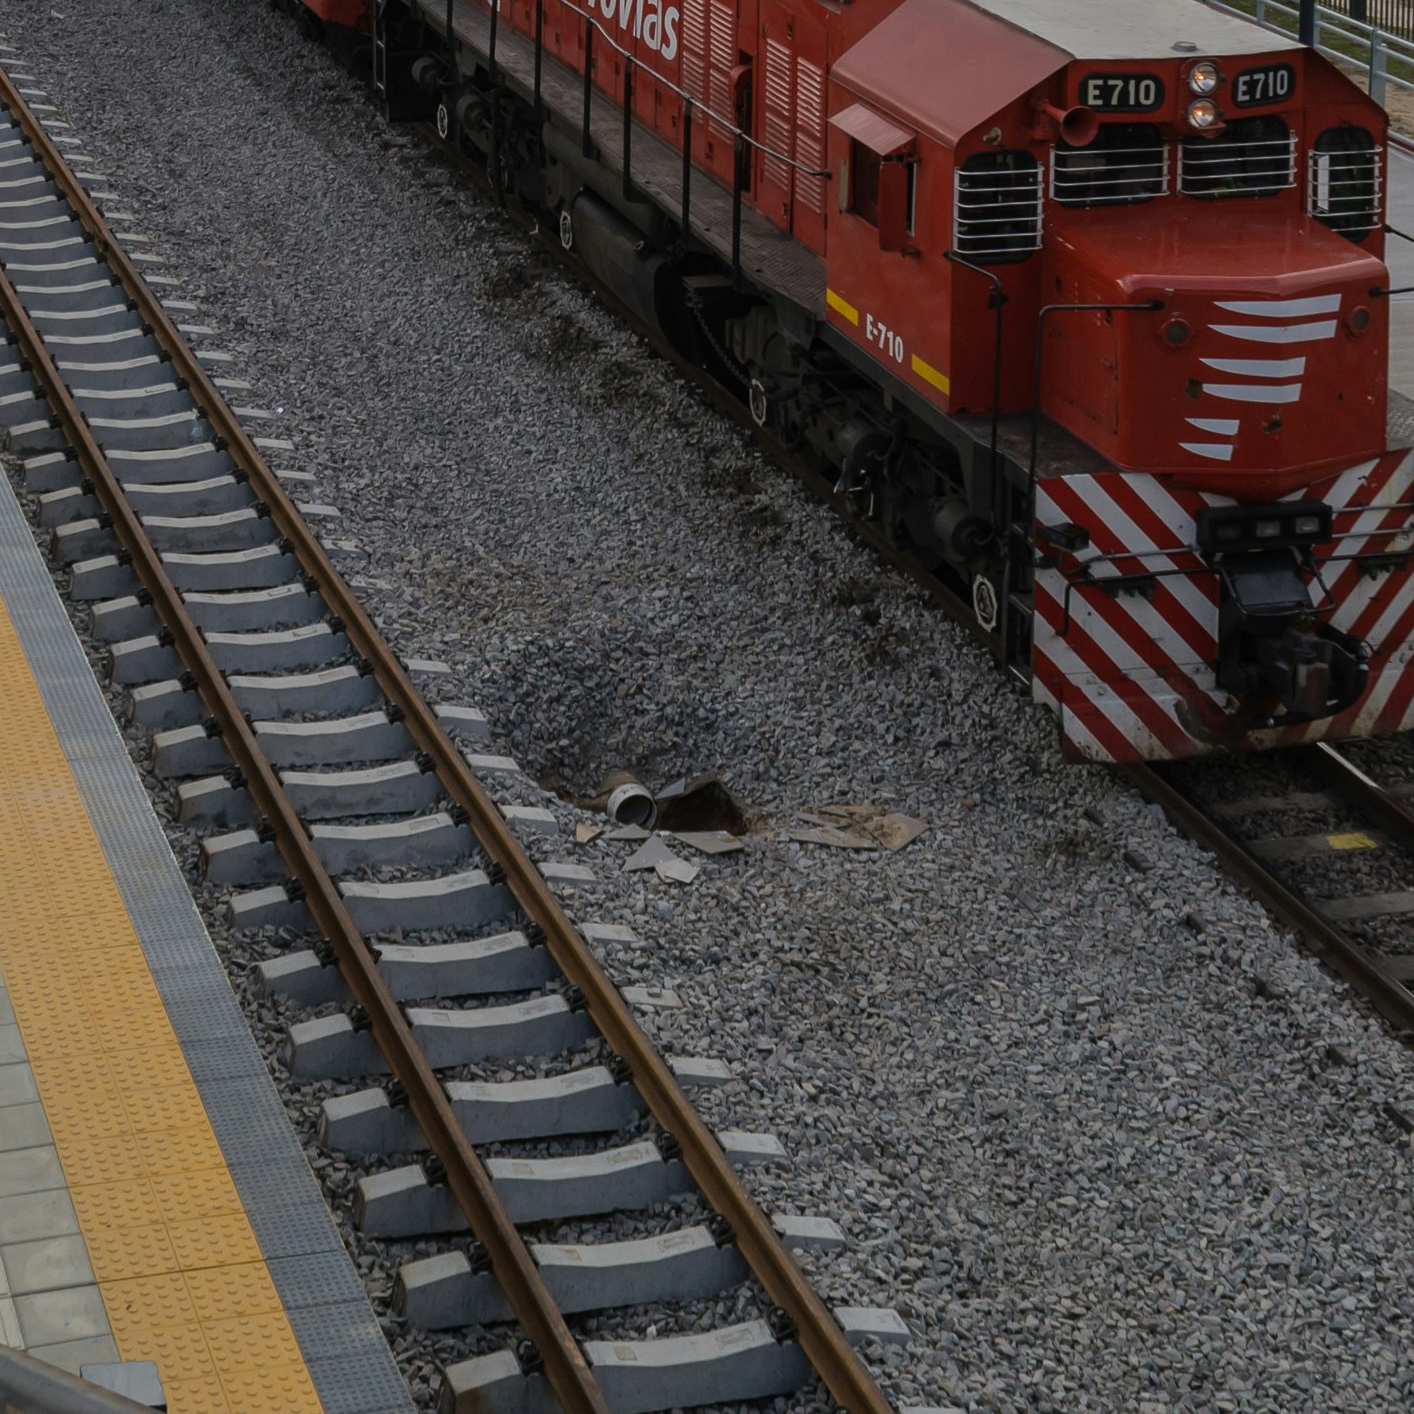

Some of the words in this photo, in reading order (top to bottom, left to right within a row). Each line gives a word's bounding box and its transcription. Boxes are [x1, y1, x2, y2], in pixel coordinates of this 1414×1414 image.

[1087, 79, 1156, 106] E710
[1236, 69, 1290, 102] E710
[866, 313, 904, 364] E-710
